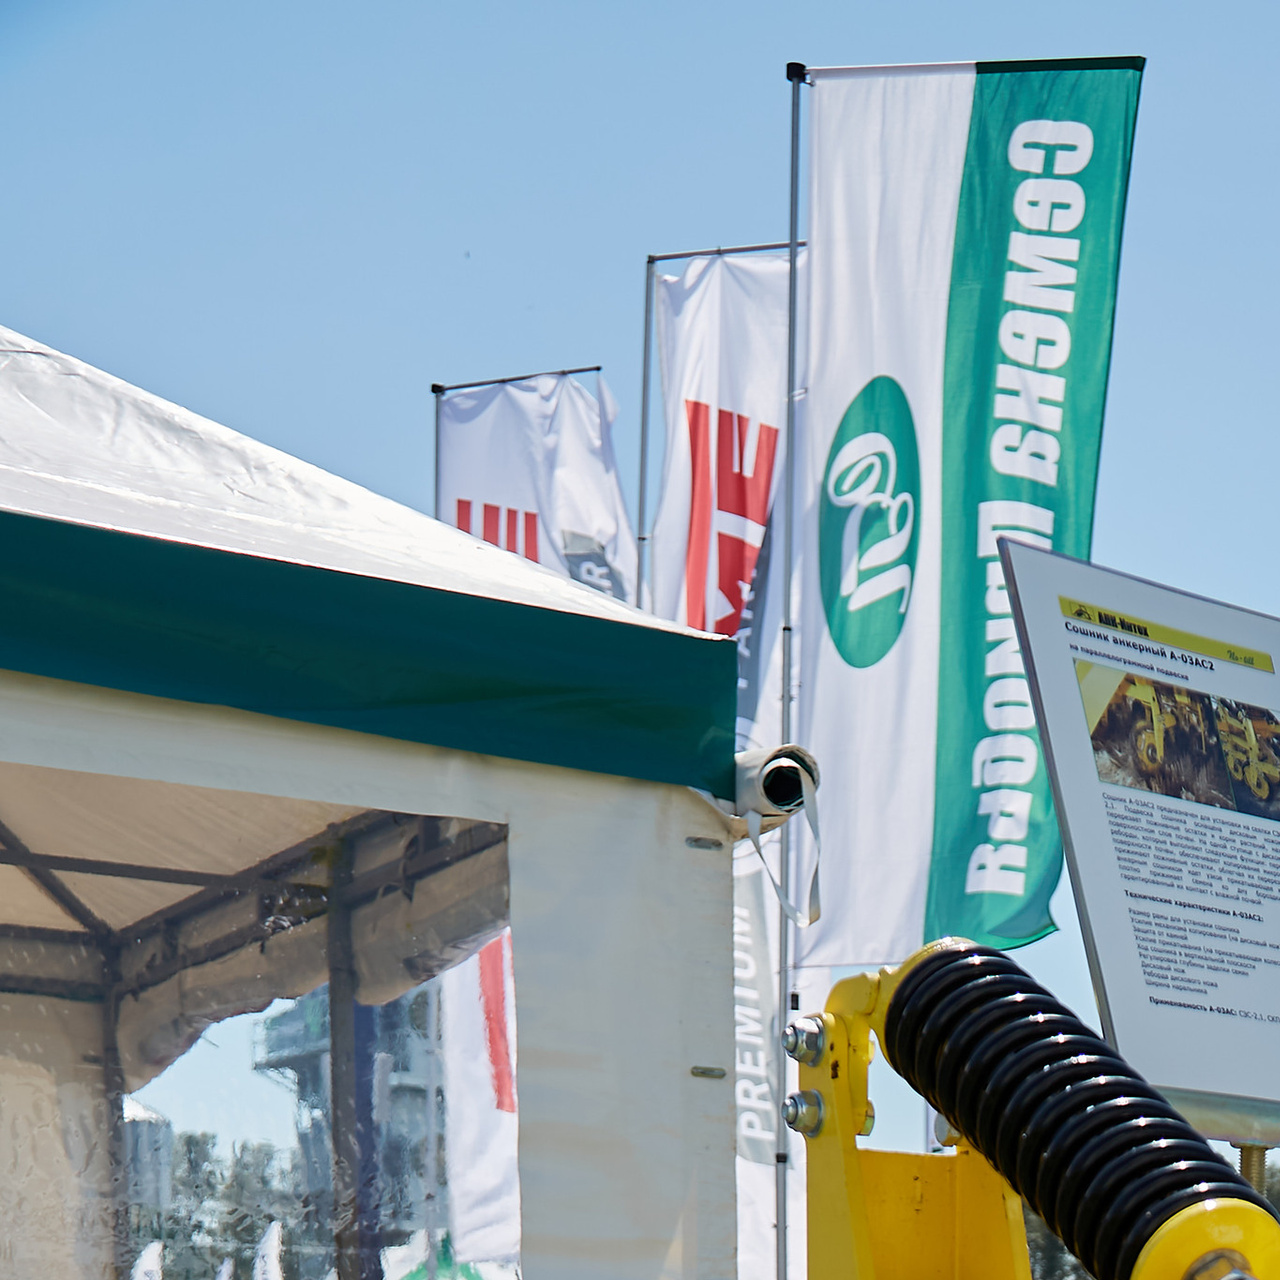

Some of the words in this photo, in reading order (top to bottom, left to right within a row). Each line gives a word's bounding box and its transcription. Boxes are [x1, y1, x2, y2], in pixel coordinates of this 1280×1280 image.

[1065, 621, 1109, 642] Сошник
[1112, 636, 1166, 658] анкерный
[1170, 651, 1214, 671] А-03АС2
